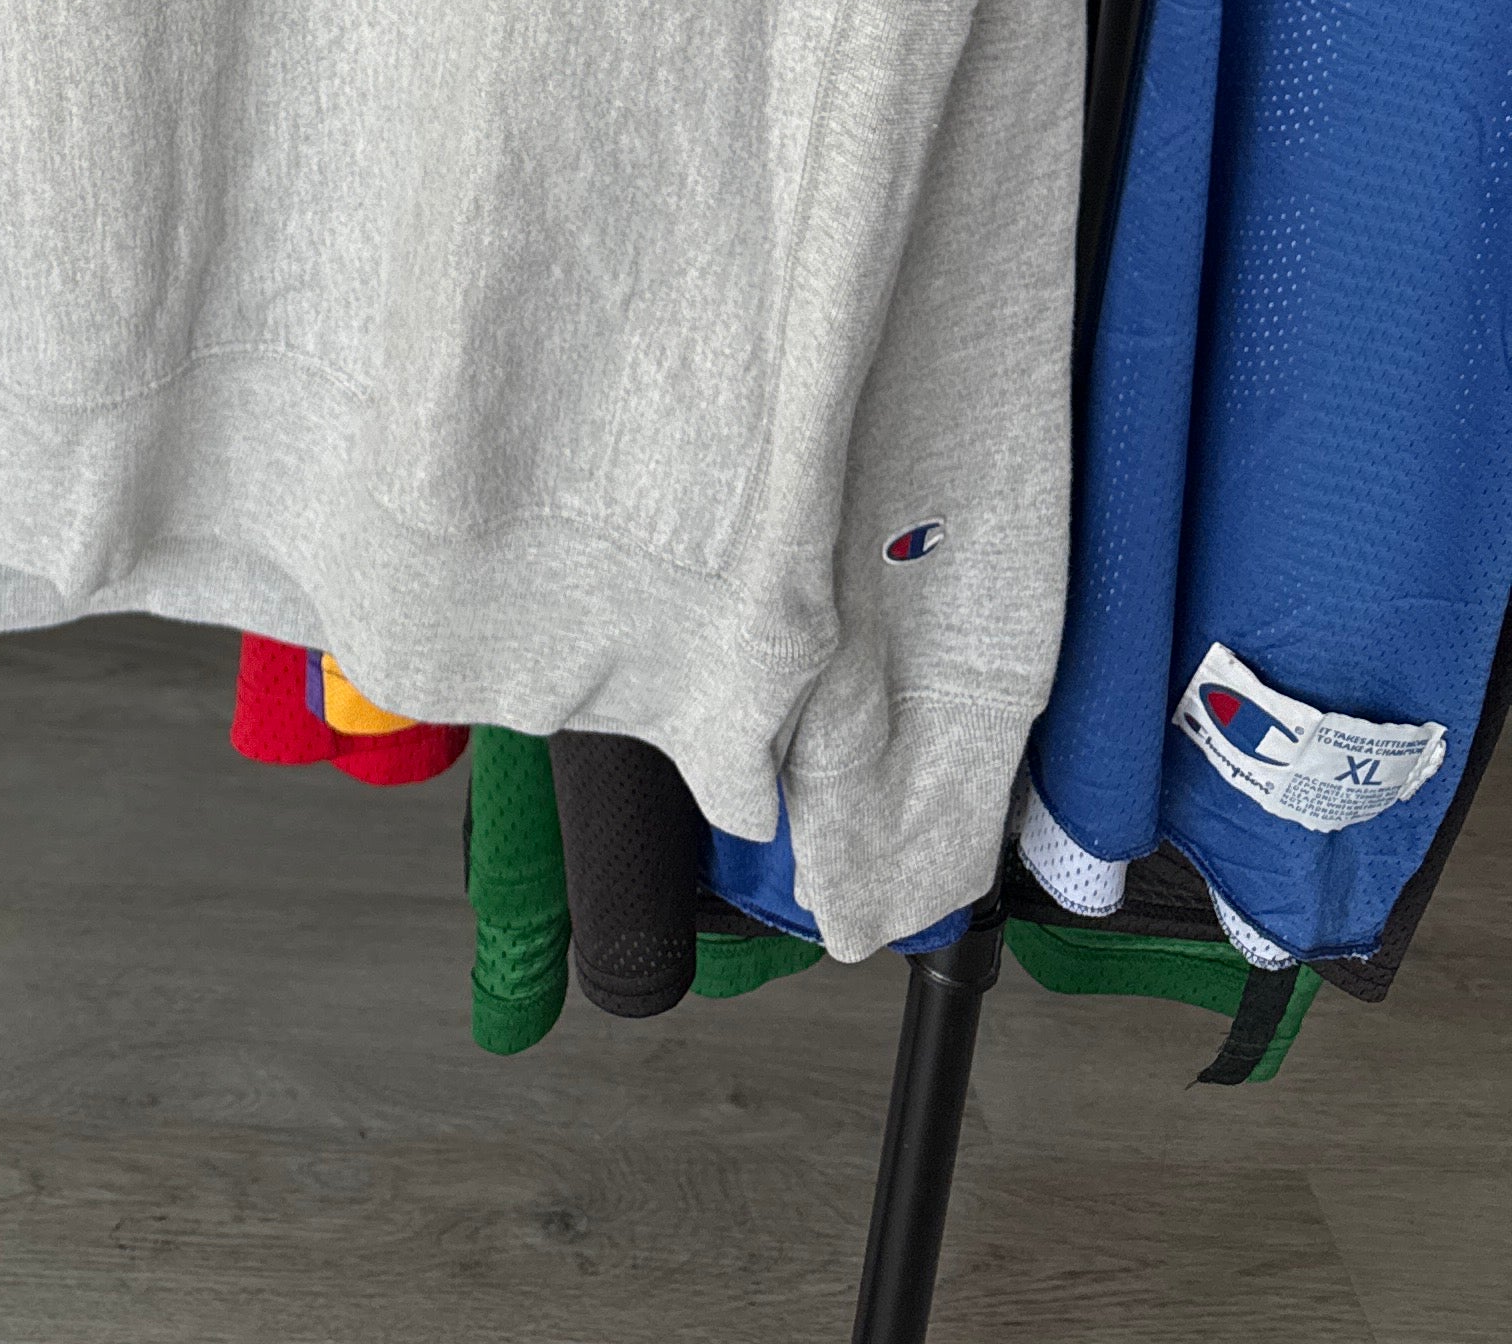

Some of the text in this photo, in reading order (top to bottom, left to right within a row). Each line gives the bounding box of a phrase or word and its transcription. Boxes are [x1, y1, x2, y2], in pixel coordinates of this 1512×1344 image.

[1319, 726, 1333, 736] IT
[1317, 734, 1333, 745] TO
[1334, 754, 1382, 786] XL
